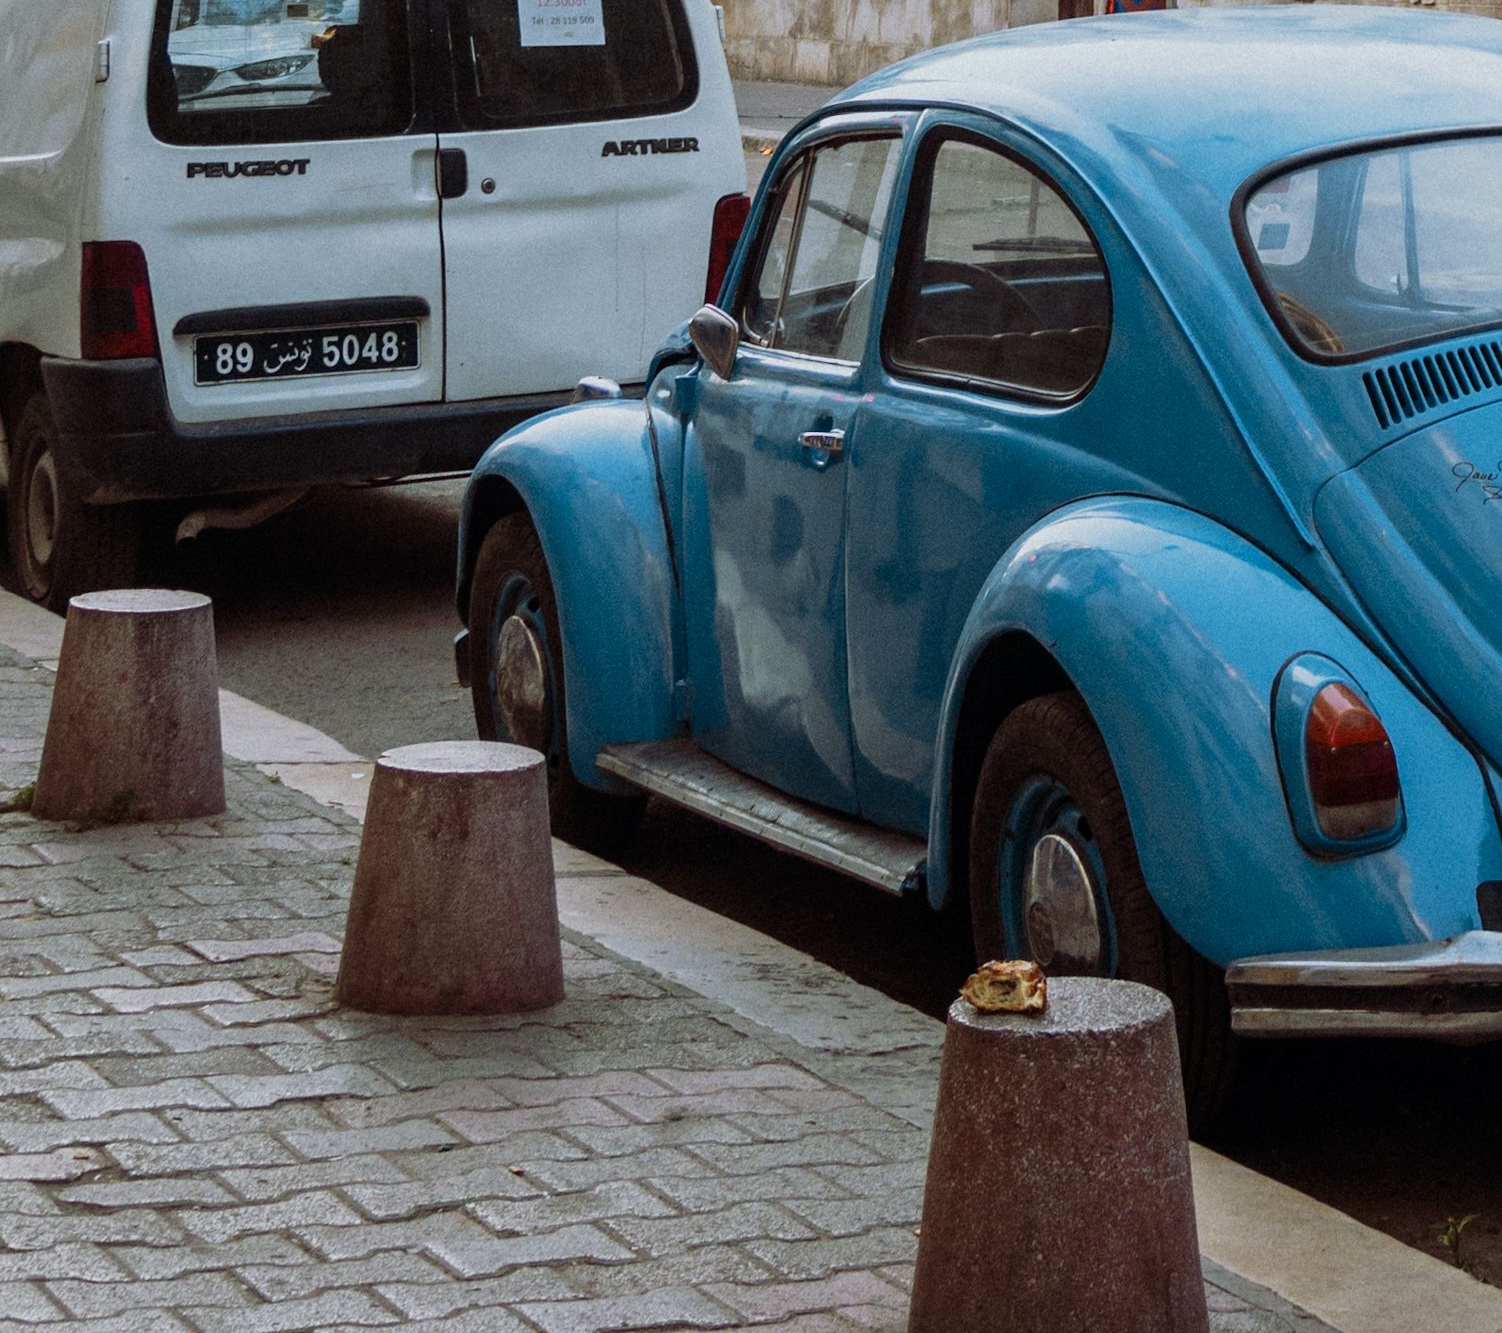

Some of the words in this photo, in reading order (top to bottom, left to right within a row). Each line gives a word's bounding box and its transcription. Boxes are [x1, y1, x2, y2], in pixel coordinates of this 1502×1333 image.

[601, 137, 699, 157] ARTNER
[186, 158, 310, 179] PEUGEOT
[215, 342, 255, 375] 89
[262, 337, 313, 372] تونس
[321, 331, 401, 368] 5048
